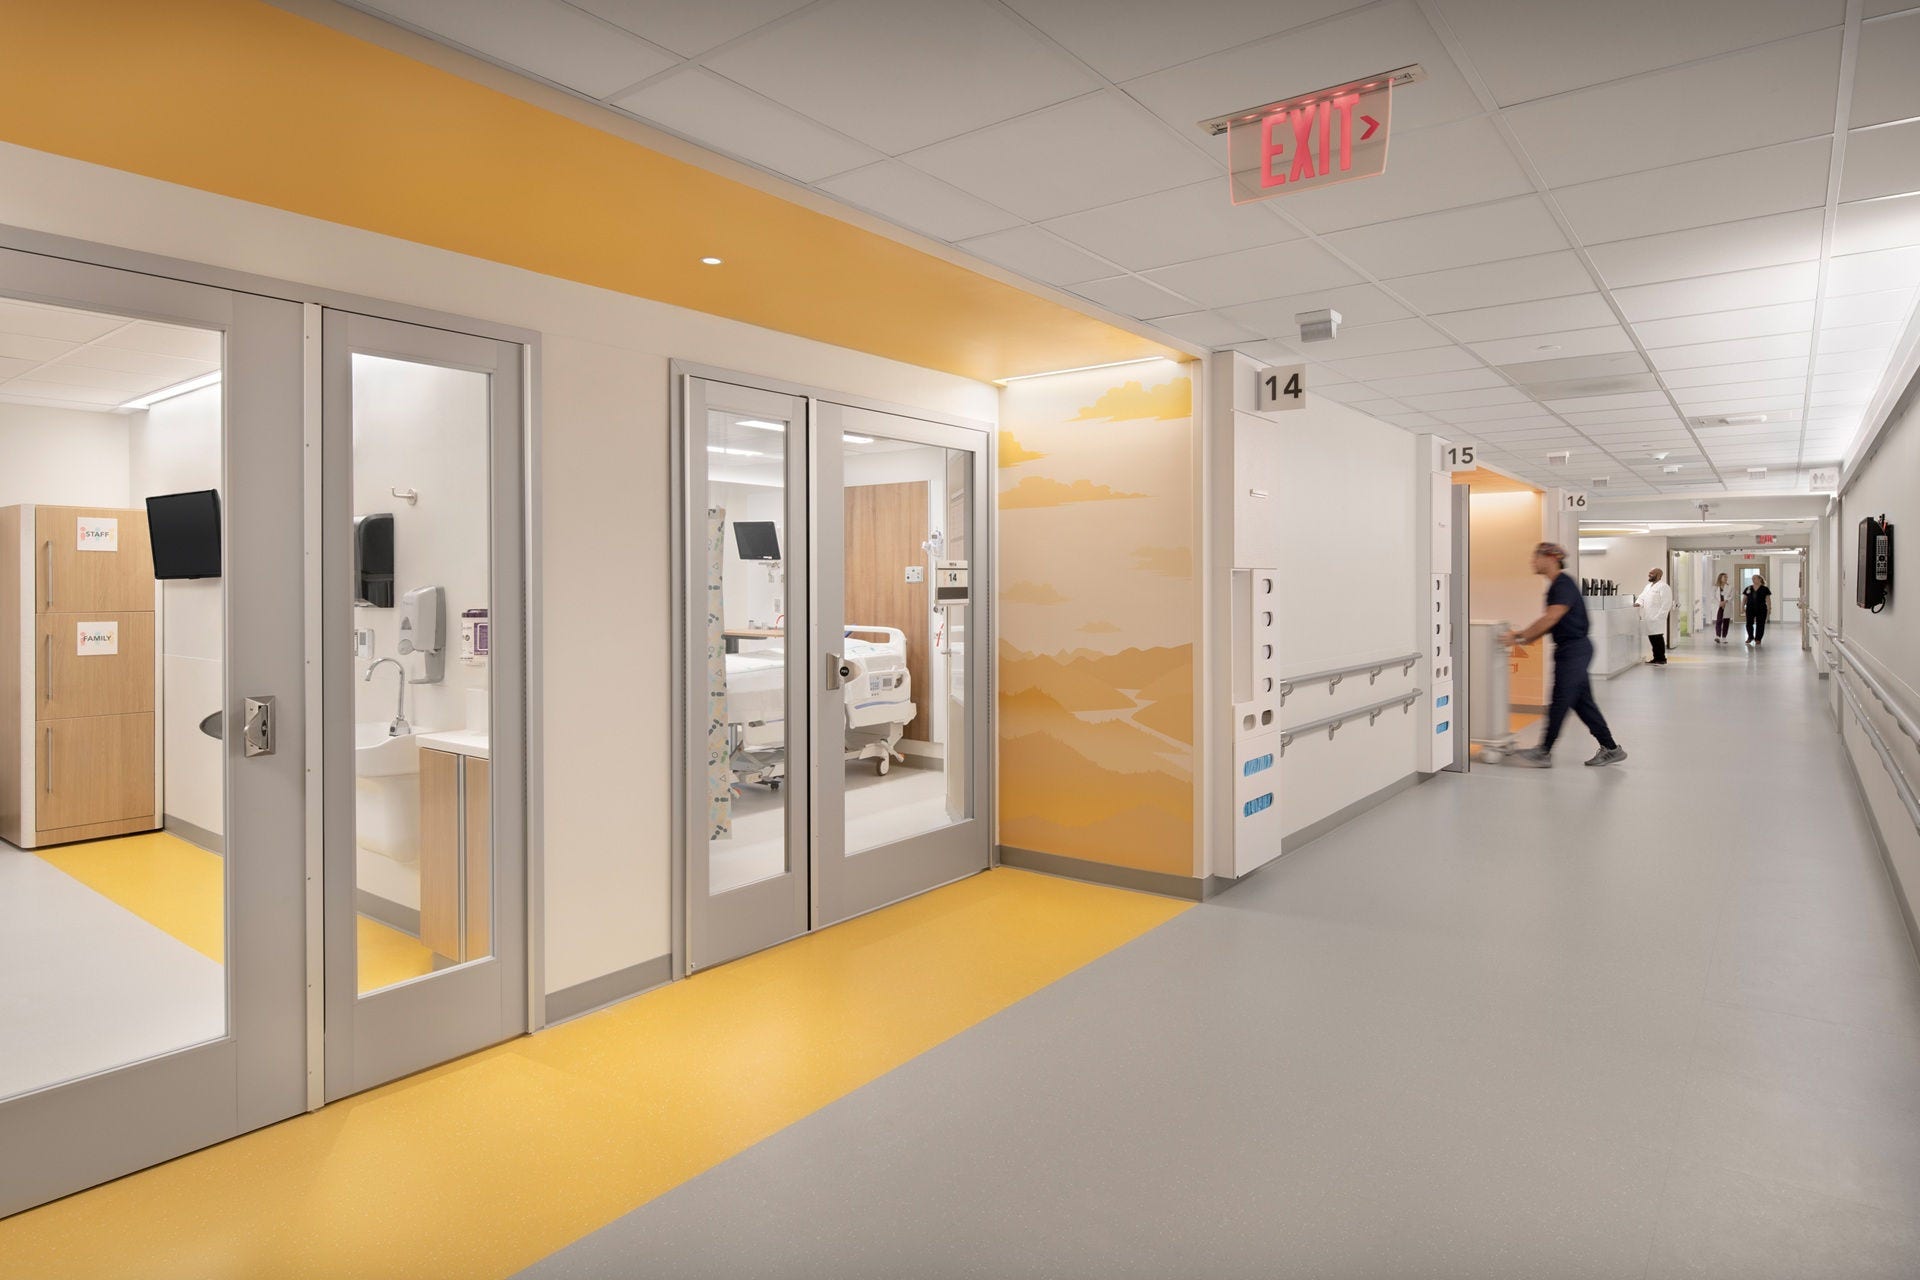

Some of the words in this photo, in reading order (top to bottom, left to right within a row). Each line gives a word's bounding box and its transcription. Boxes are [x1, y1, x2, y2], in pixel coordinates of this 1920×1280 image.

[1261, 93, 1360, 188] EXIT
[1265, 373, 1303, 401] 14
[1448, 446, 1474, 465] 15
[1567, 495, 1586, 507] 16
[949, 573, 957, 582] 14
